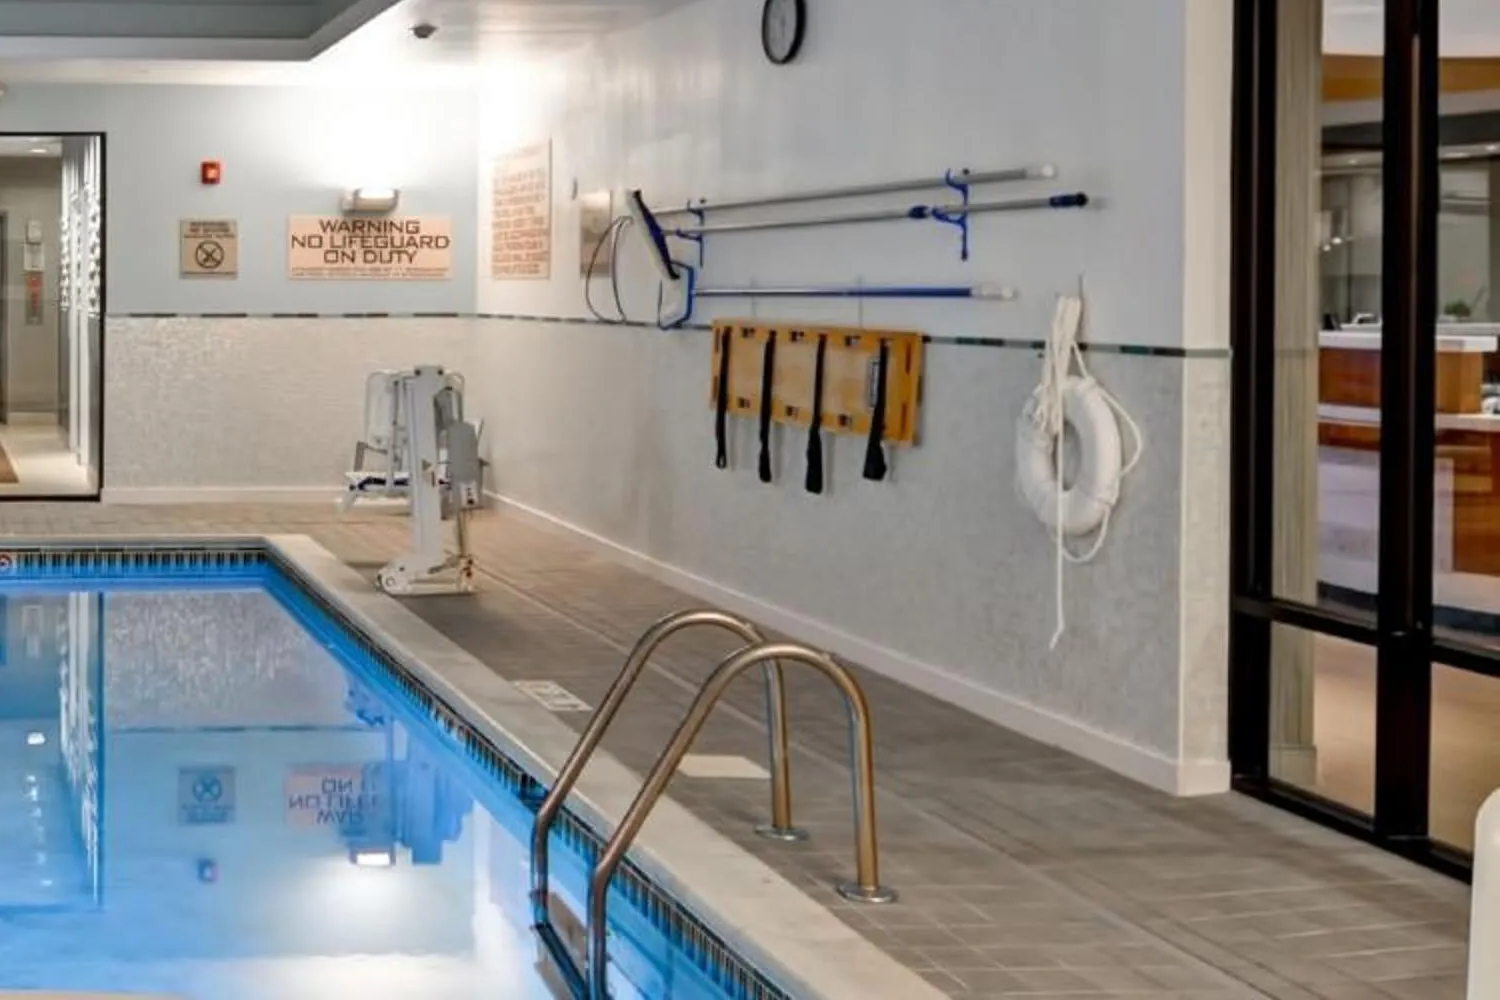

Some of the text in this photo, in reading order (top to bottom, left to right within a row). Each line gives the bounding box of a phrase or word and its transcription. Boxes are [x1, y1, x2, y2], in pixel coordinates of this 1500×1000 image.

[319, 219, 421, 234] WARNING
[291, 234, 450, 249] NO LIFEGUARD
[323, 250, 418, 264] ON DUTY
